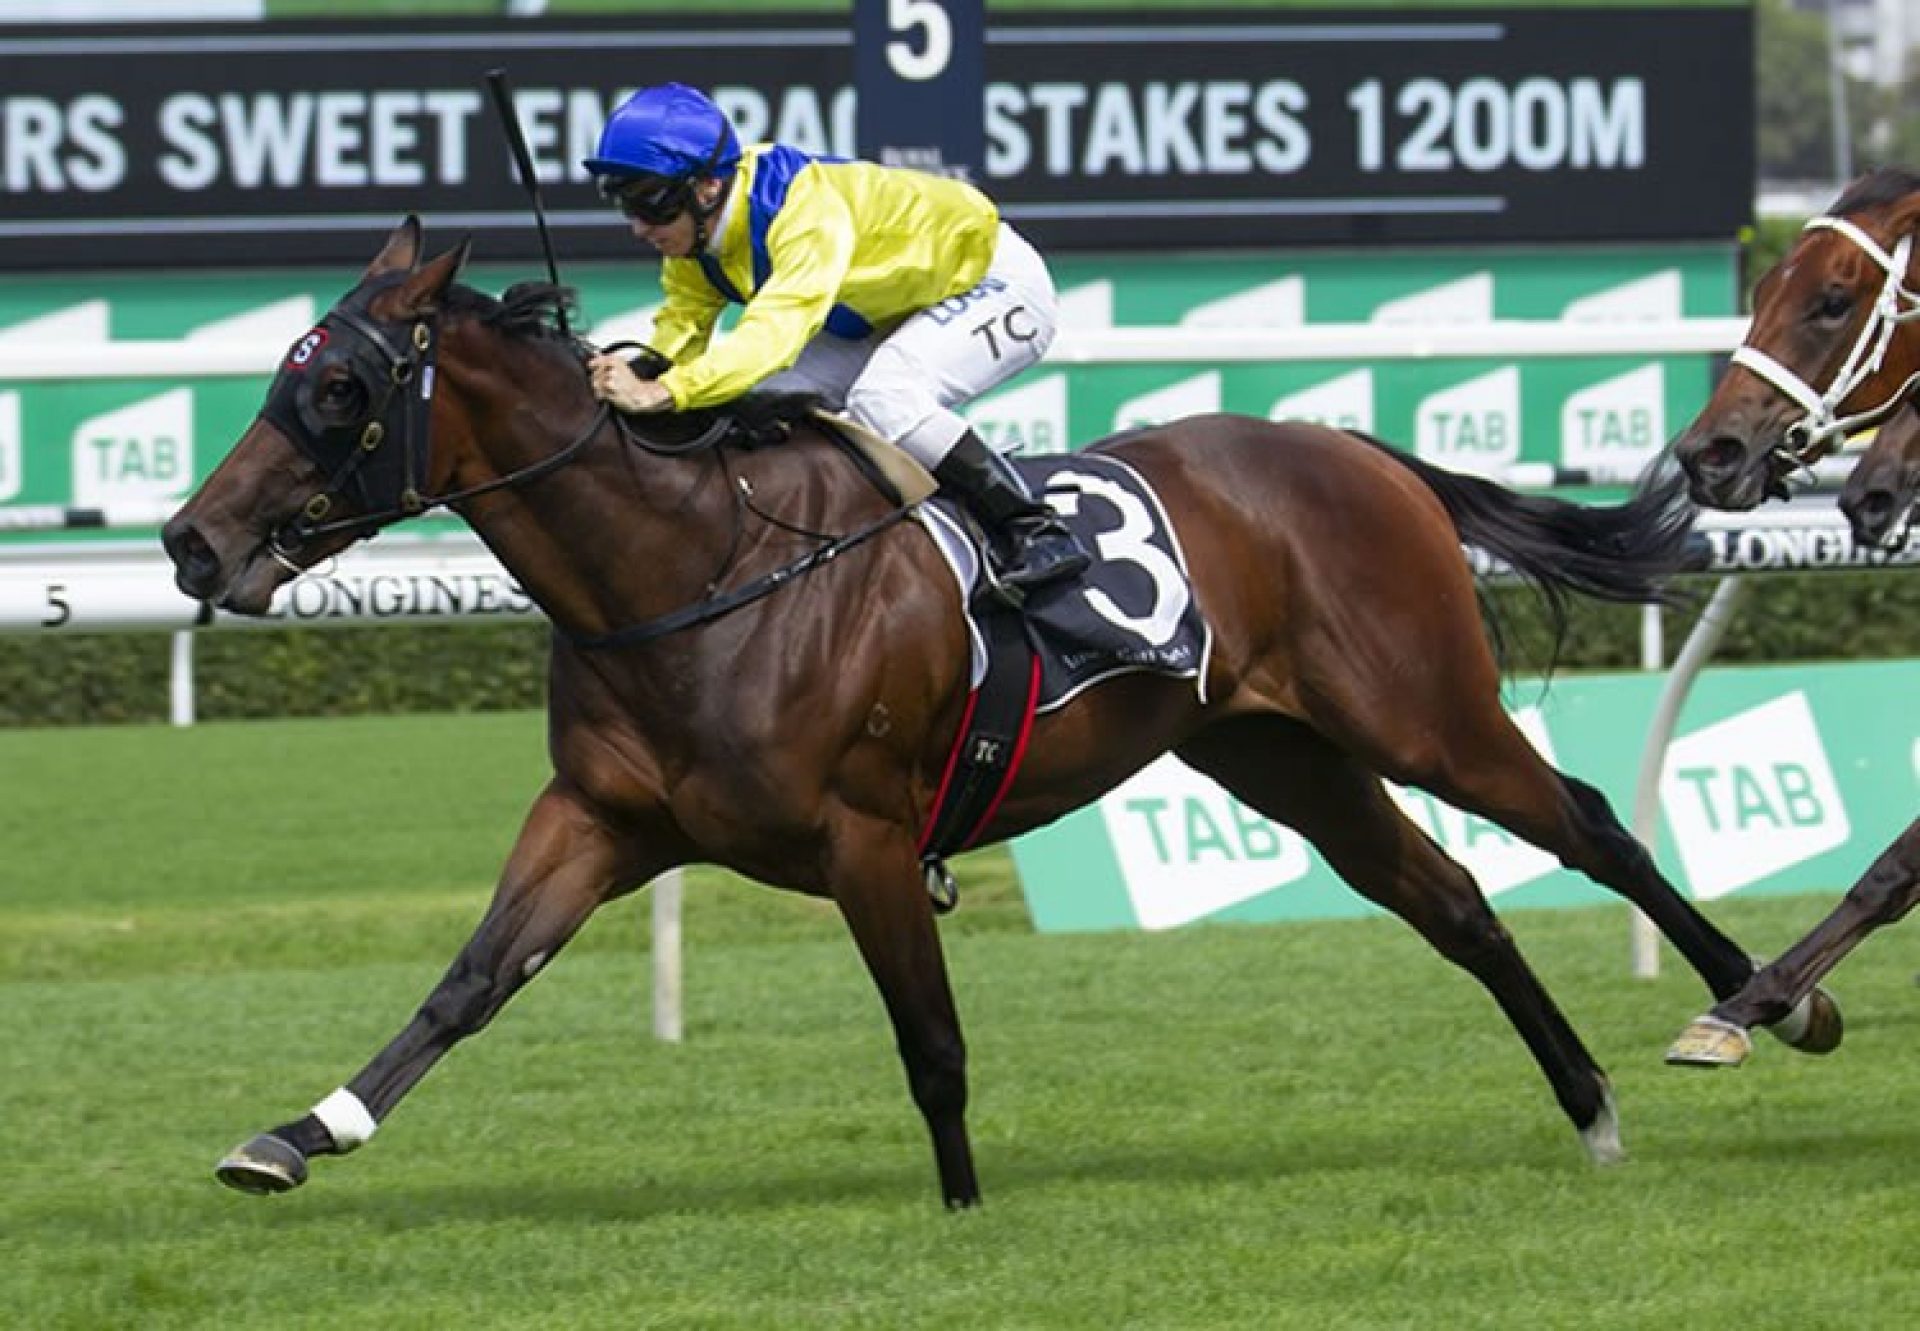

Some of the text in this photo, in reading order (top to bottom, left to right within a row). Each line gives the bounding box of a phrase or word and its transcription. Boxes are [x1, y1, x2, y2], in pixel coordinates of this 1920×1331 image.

[886, 0, 953, 80] 5
[158, 92, 482, 189] SWEET
[984, 80, 1311, 176] STAKES
[1347, 78, 1646, 171] 1200M
[970, 304, 1038, 361] TC
[1431, 410, 1508, 453] TAB
[1577, 408, 1653, 449] TAB
[88, 436, 180, 484] TAB
[1043, 470, 1191, 646] 3
[41, 584, 71, 628] 5
[268, 574, 533, 618] ONGINES
[1677, 762, 1825, 832] TAB
[1124, 796, 1282, 864] TAB
